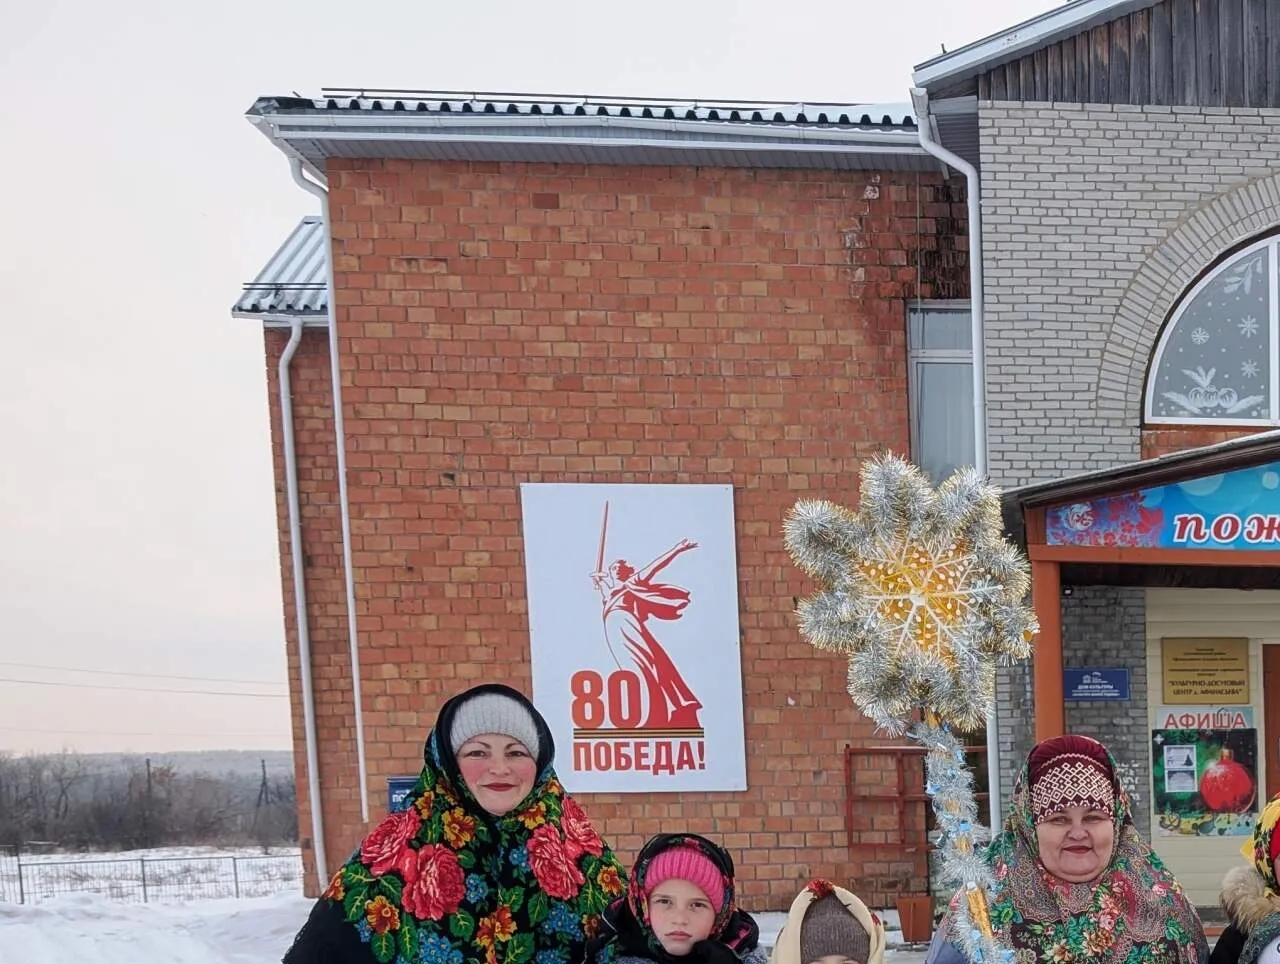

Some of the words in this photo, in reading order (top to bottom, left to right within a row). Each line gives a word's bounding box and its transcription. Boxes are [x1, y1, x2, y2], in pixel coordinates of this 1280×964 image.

[571, 670, 642, 728] 80
[1165, 713, 1247, 729] АФИША
[573, 741, 706, 775] ПОБЕДА!
